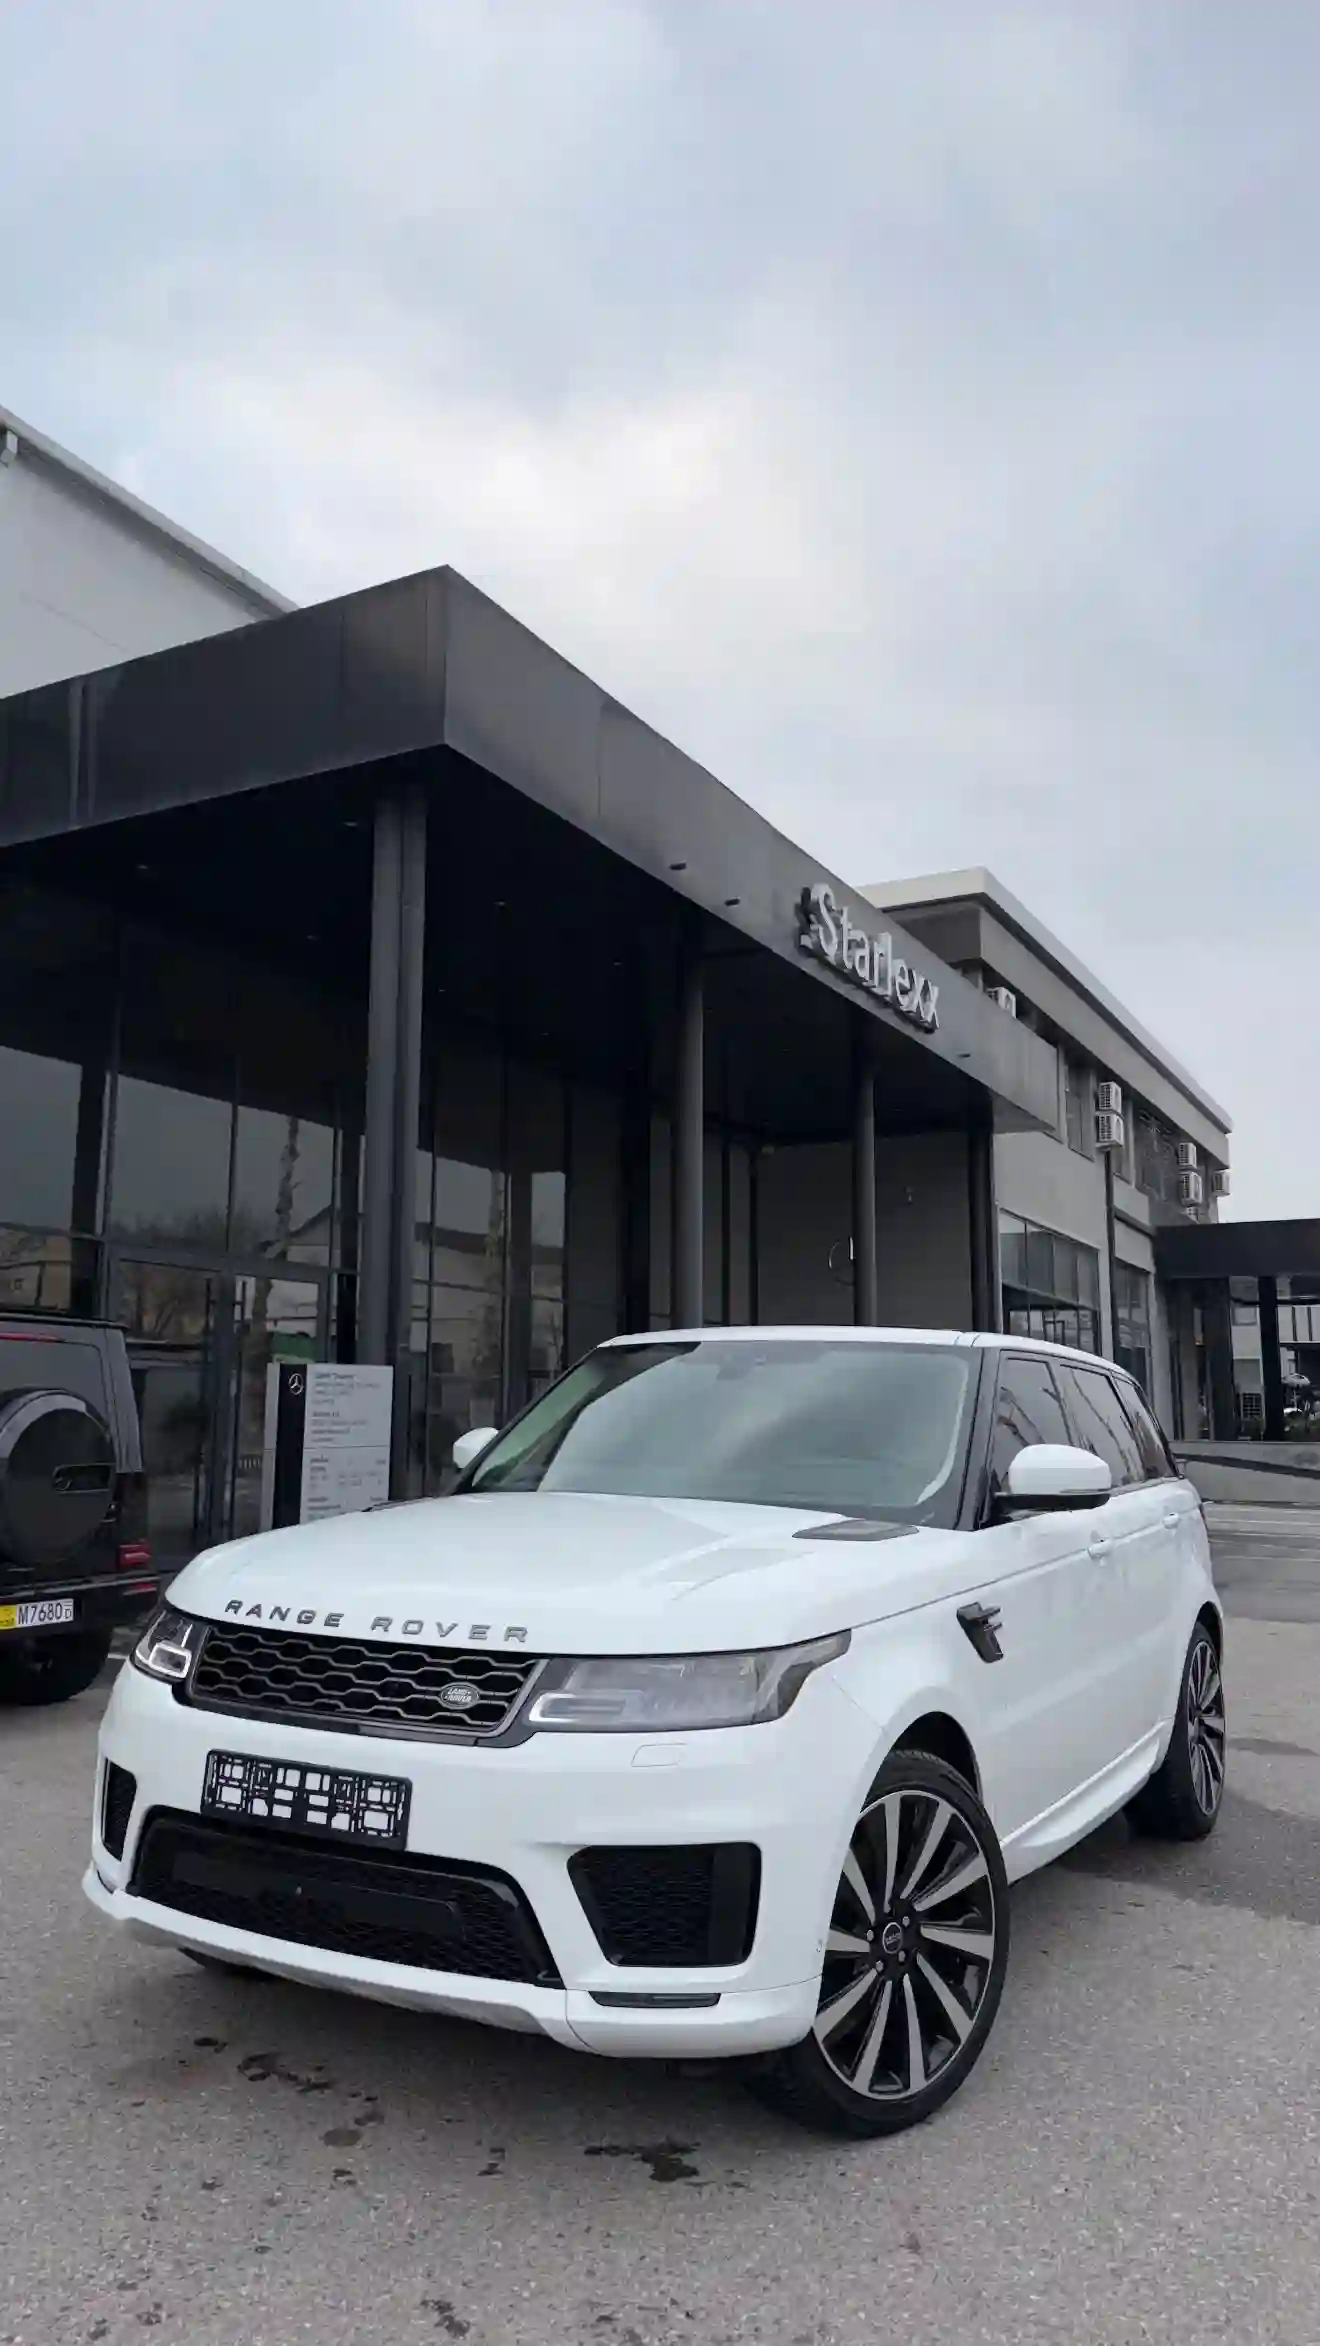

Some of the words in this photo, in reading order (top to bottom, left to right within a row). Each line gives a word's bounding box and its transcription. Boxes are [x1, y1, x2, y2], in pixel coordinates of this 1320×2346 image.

[799, 884, 940, 1029] Starlexx
[224, 1599, 344, 1628] RANGE
[370, 1616, 528, 1643] ROVER
